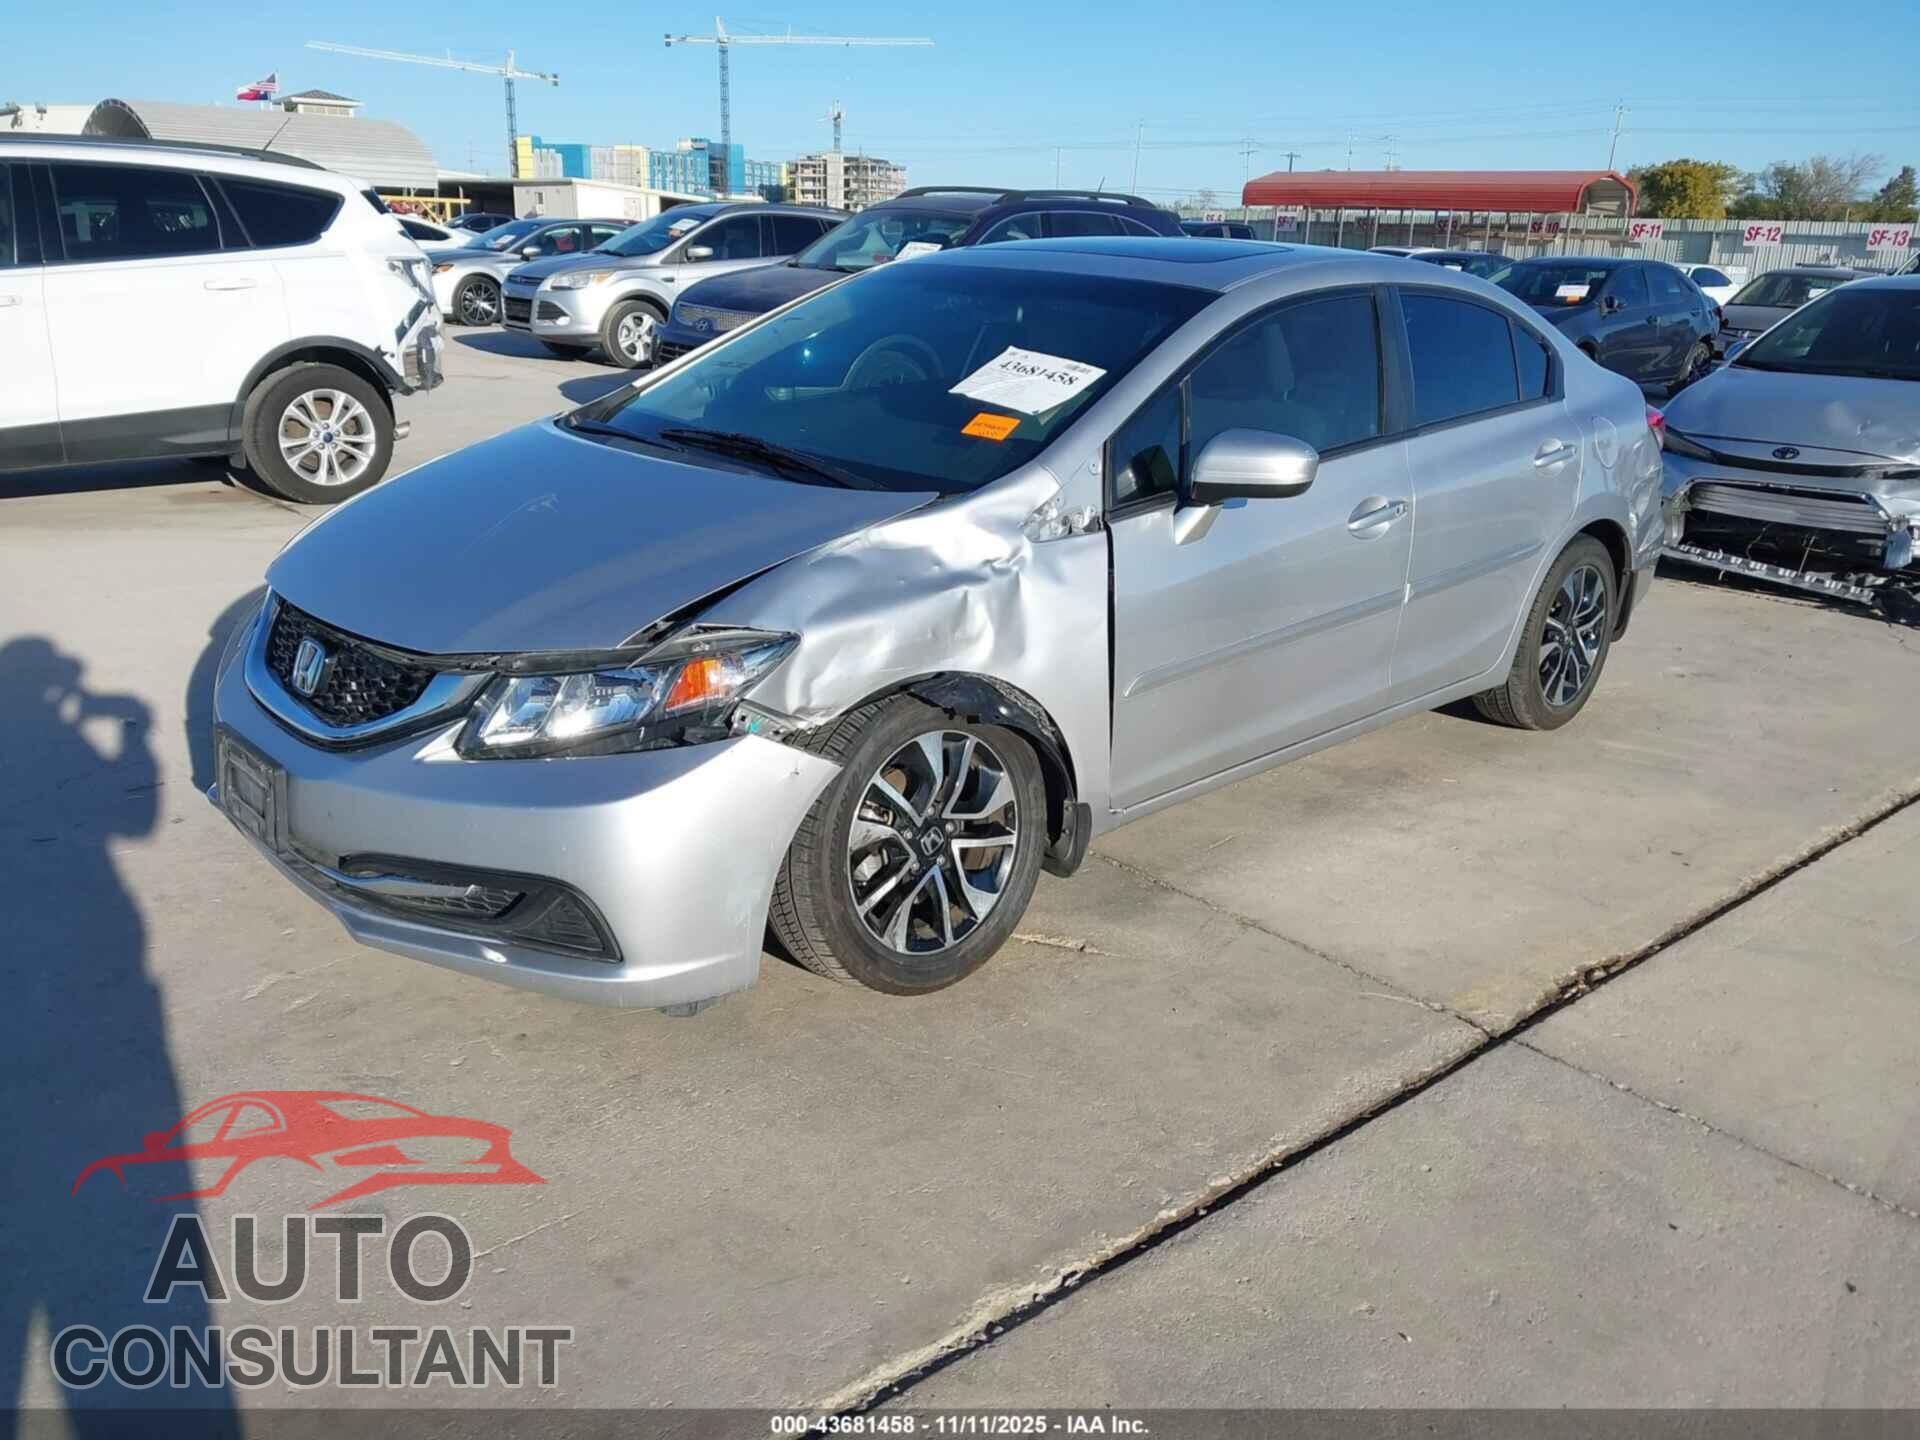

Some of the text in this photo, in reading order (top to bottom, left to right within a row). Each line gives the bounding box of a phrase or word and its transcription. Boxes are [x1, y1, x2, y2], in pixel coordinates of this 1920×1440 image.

[1438, 219, 1457, 234] SF9
[1530, 222, 1560, 234] SF10
[1630, 223, 1661, 238] SF-11
[1745, 226, 1781, 242] SF-12
[1869, 229, 1909, 246] SF-13
[1000, 360, 1079, 385] 43681458
